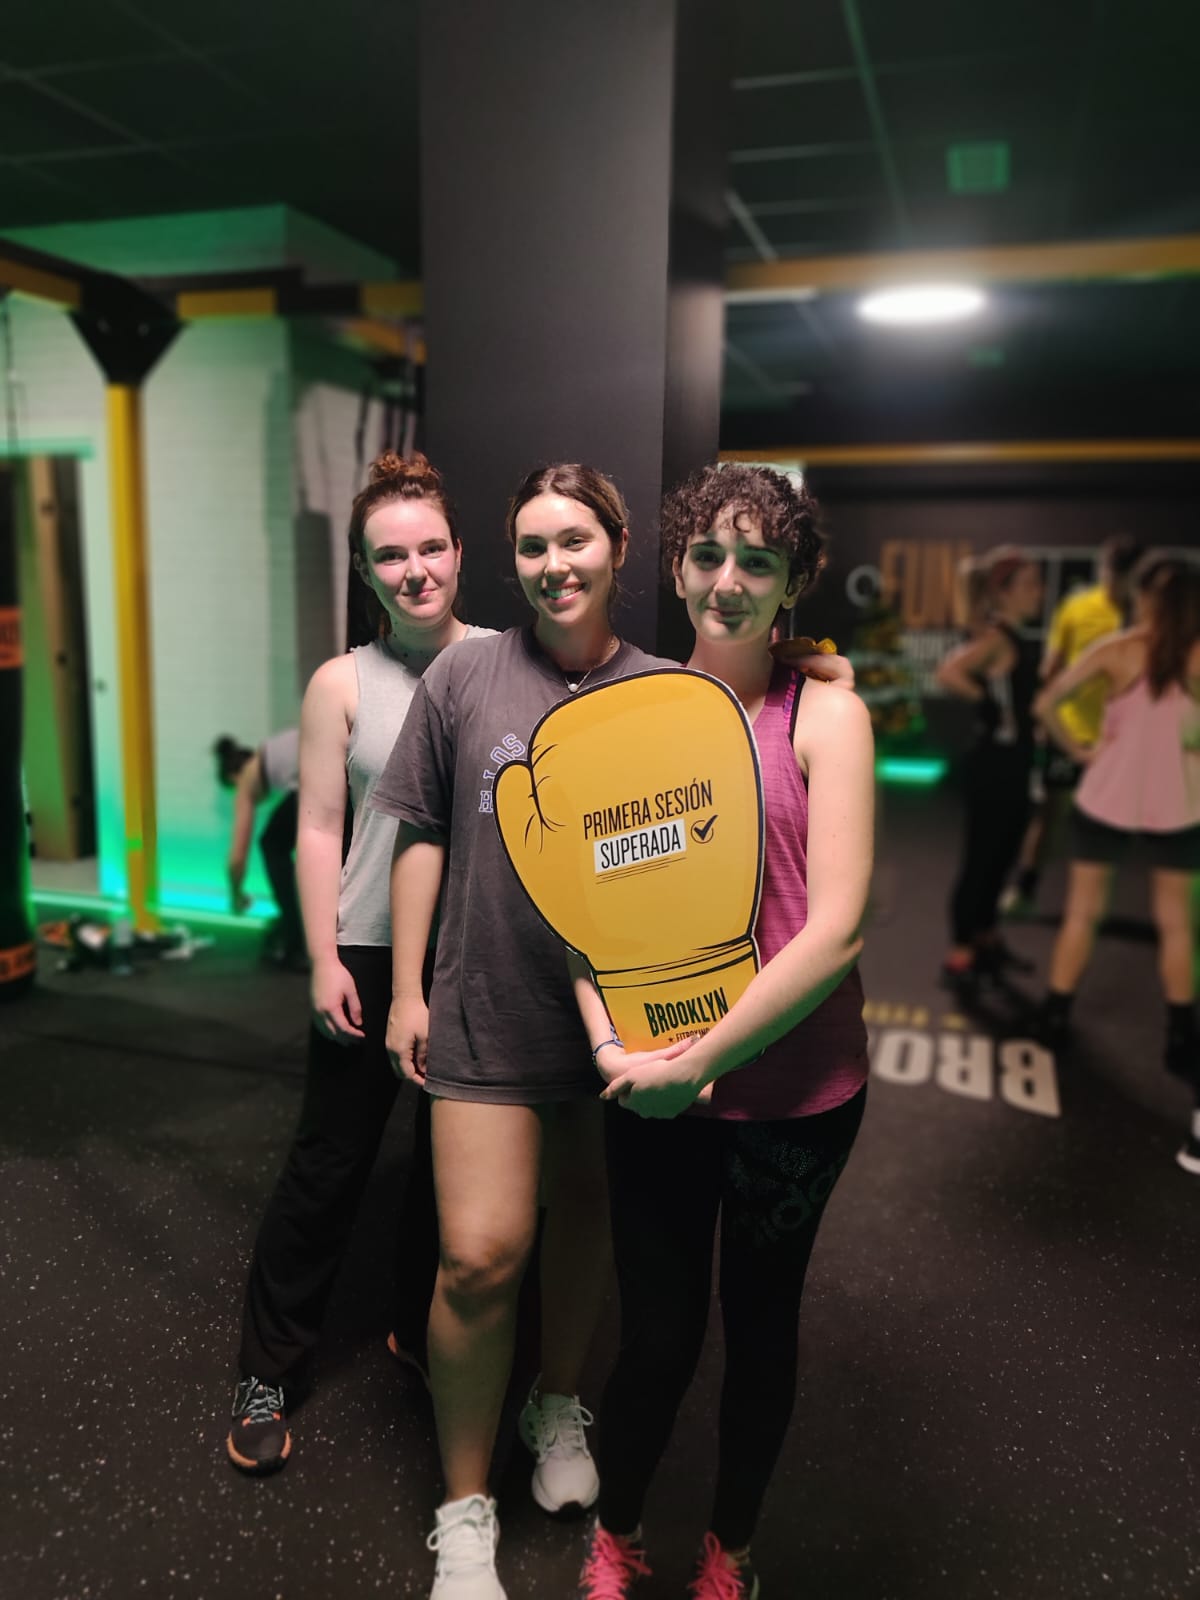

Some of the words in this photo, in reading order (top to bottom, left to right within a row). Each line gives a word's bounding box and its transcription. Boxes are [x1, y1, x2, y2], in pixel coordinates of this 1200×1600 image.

[584, 797, 651, 840] PRIMERA
[655, 778, 713, 821] SESIÓN
[600, 824, 682, 869] SUPERADA
[644, 987, 729, 1038] BROOKLYN
[868, 1030, 1061, 1117] BRO
